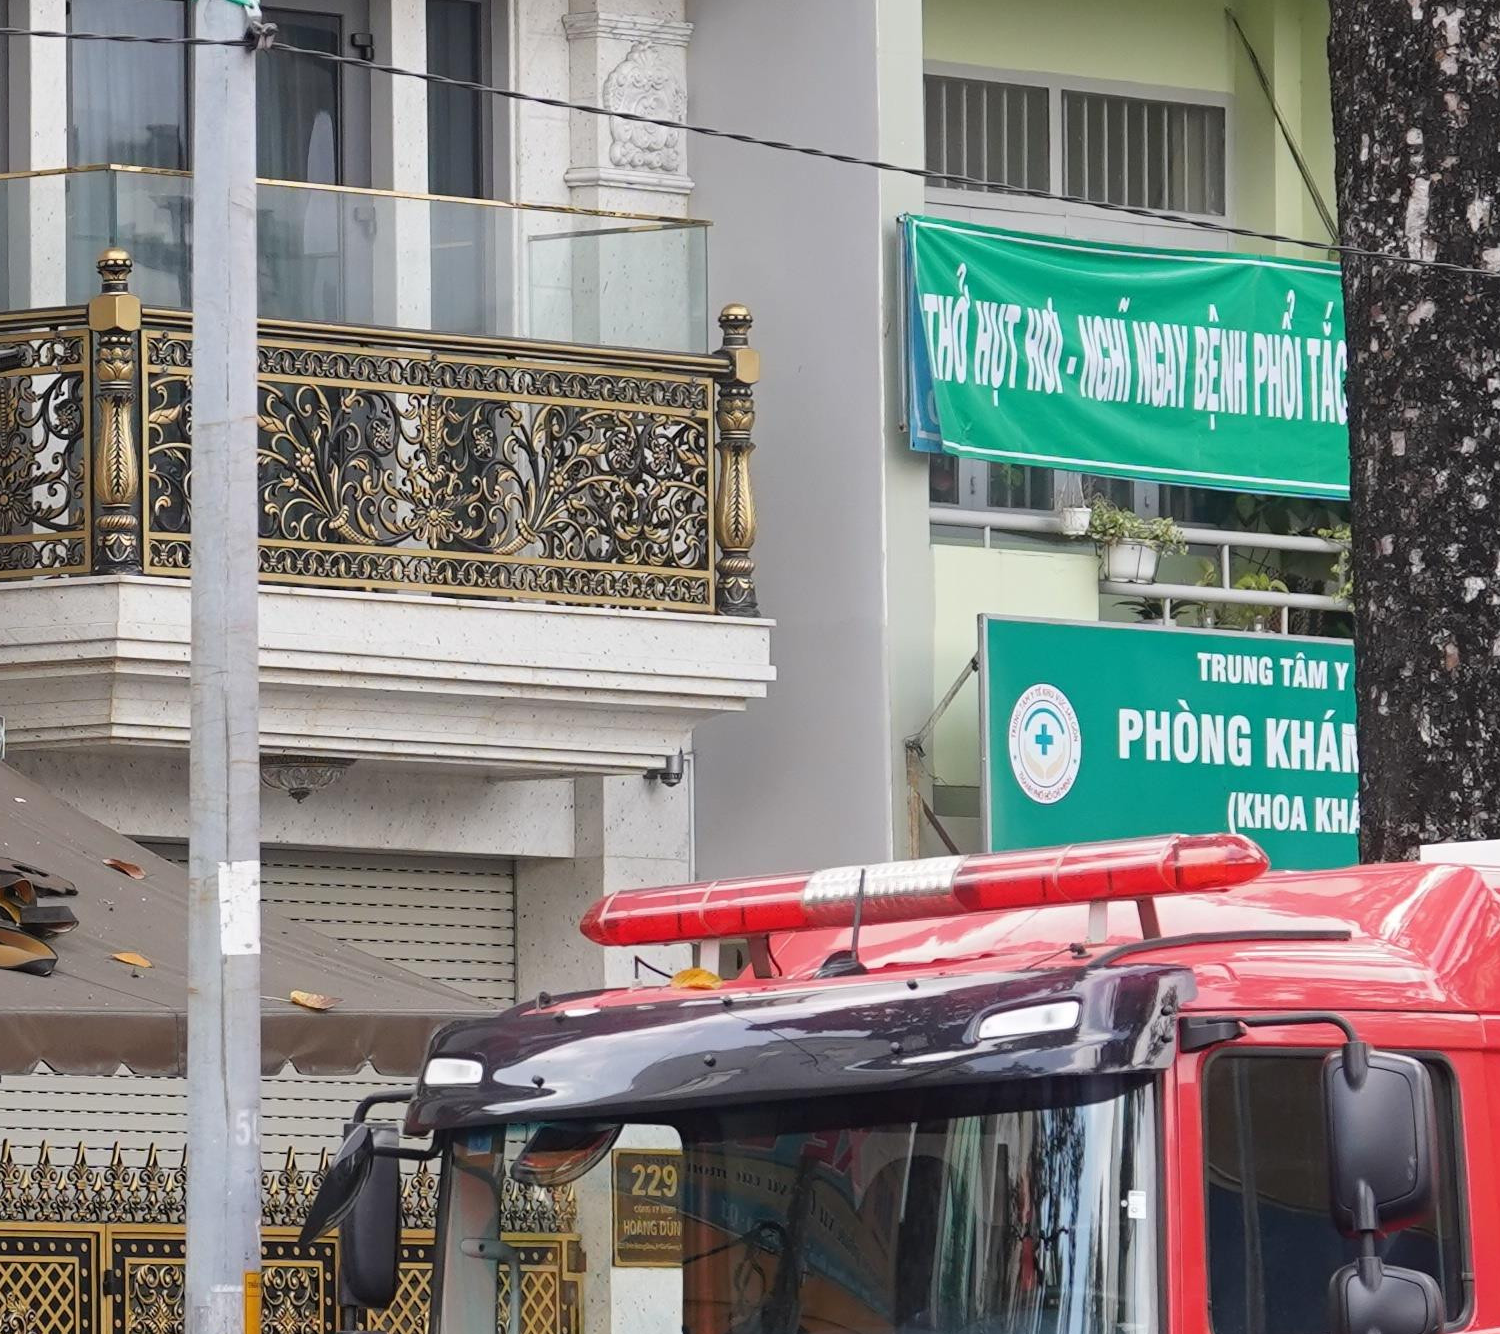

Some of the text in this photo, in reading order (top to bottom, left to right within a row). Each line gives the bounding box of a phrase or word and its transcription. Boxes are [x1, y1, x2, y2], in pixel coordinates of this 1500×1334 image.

[923, 264, 971, 384] THỞ
[974, 299, 1021, 408] HỤT
[1025, 297, 1063, 394] HƠI
[1079, 298, 1132, 406] NGHĨ
[1138, 323, 1189, 410] NGAY
[1194, 306, 1249, 431] BỆNH
[1253, 289, 1303, 421] PHỔI
[1198, 651, 1273, 687] TRUNG
[1280, 651, 1327, 690] TÂM
[1334, 661, 1349, 691] Y
[1119, 699, 1252, 769] PHÒNG
[1228, 791, 1307, 835] (KHOA
[632, 1164, 678, 1197] 229
[624, 1217, 658, 1236] HOÀNG
